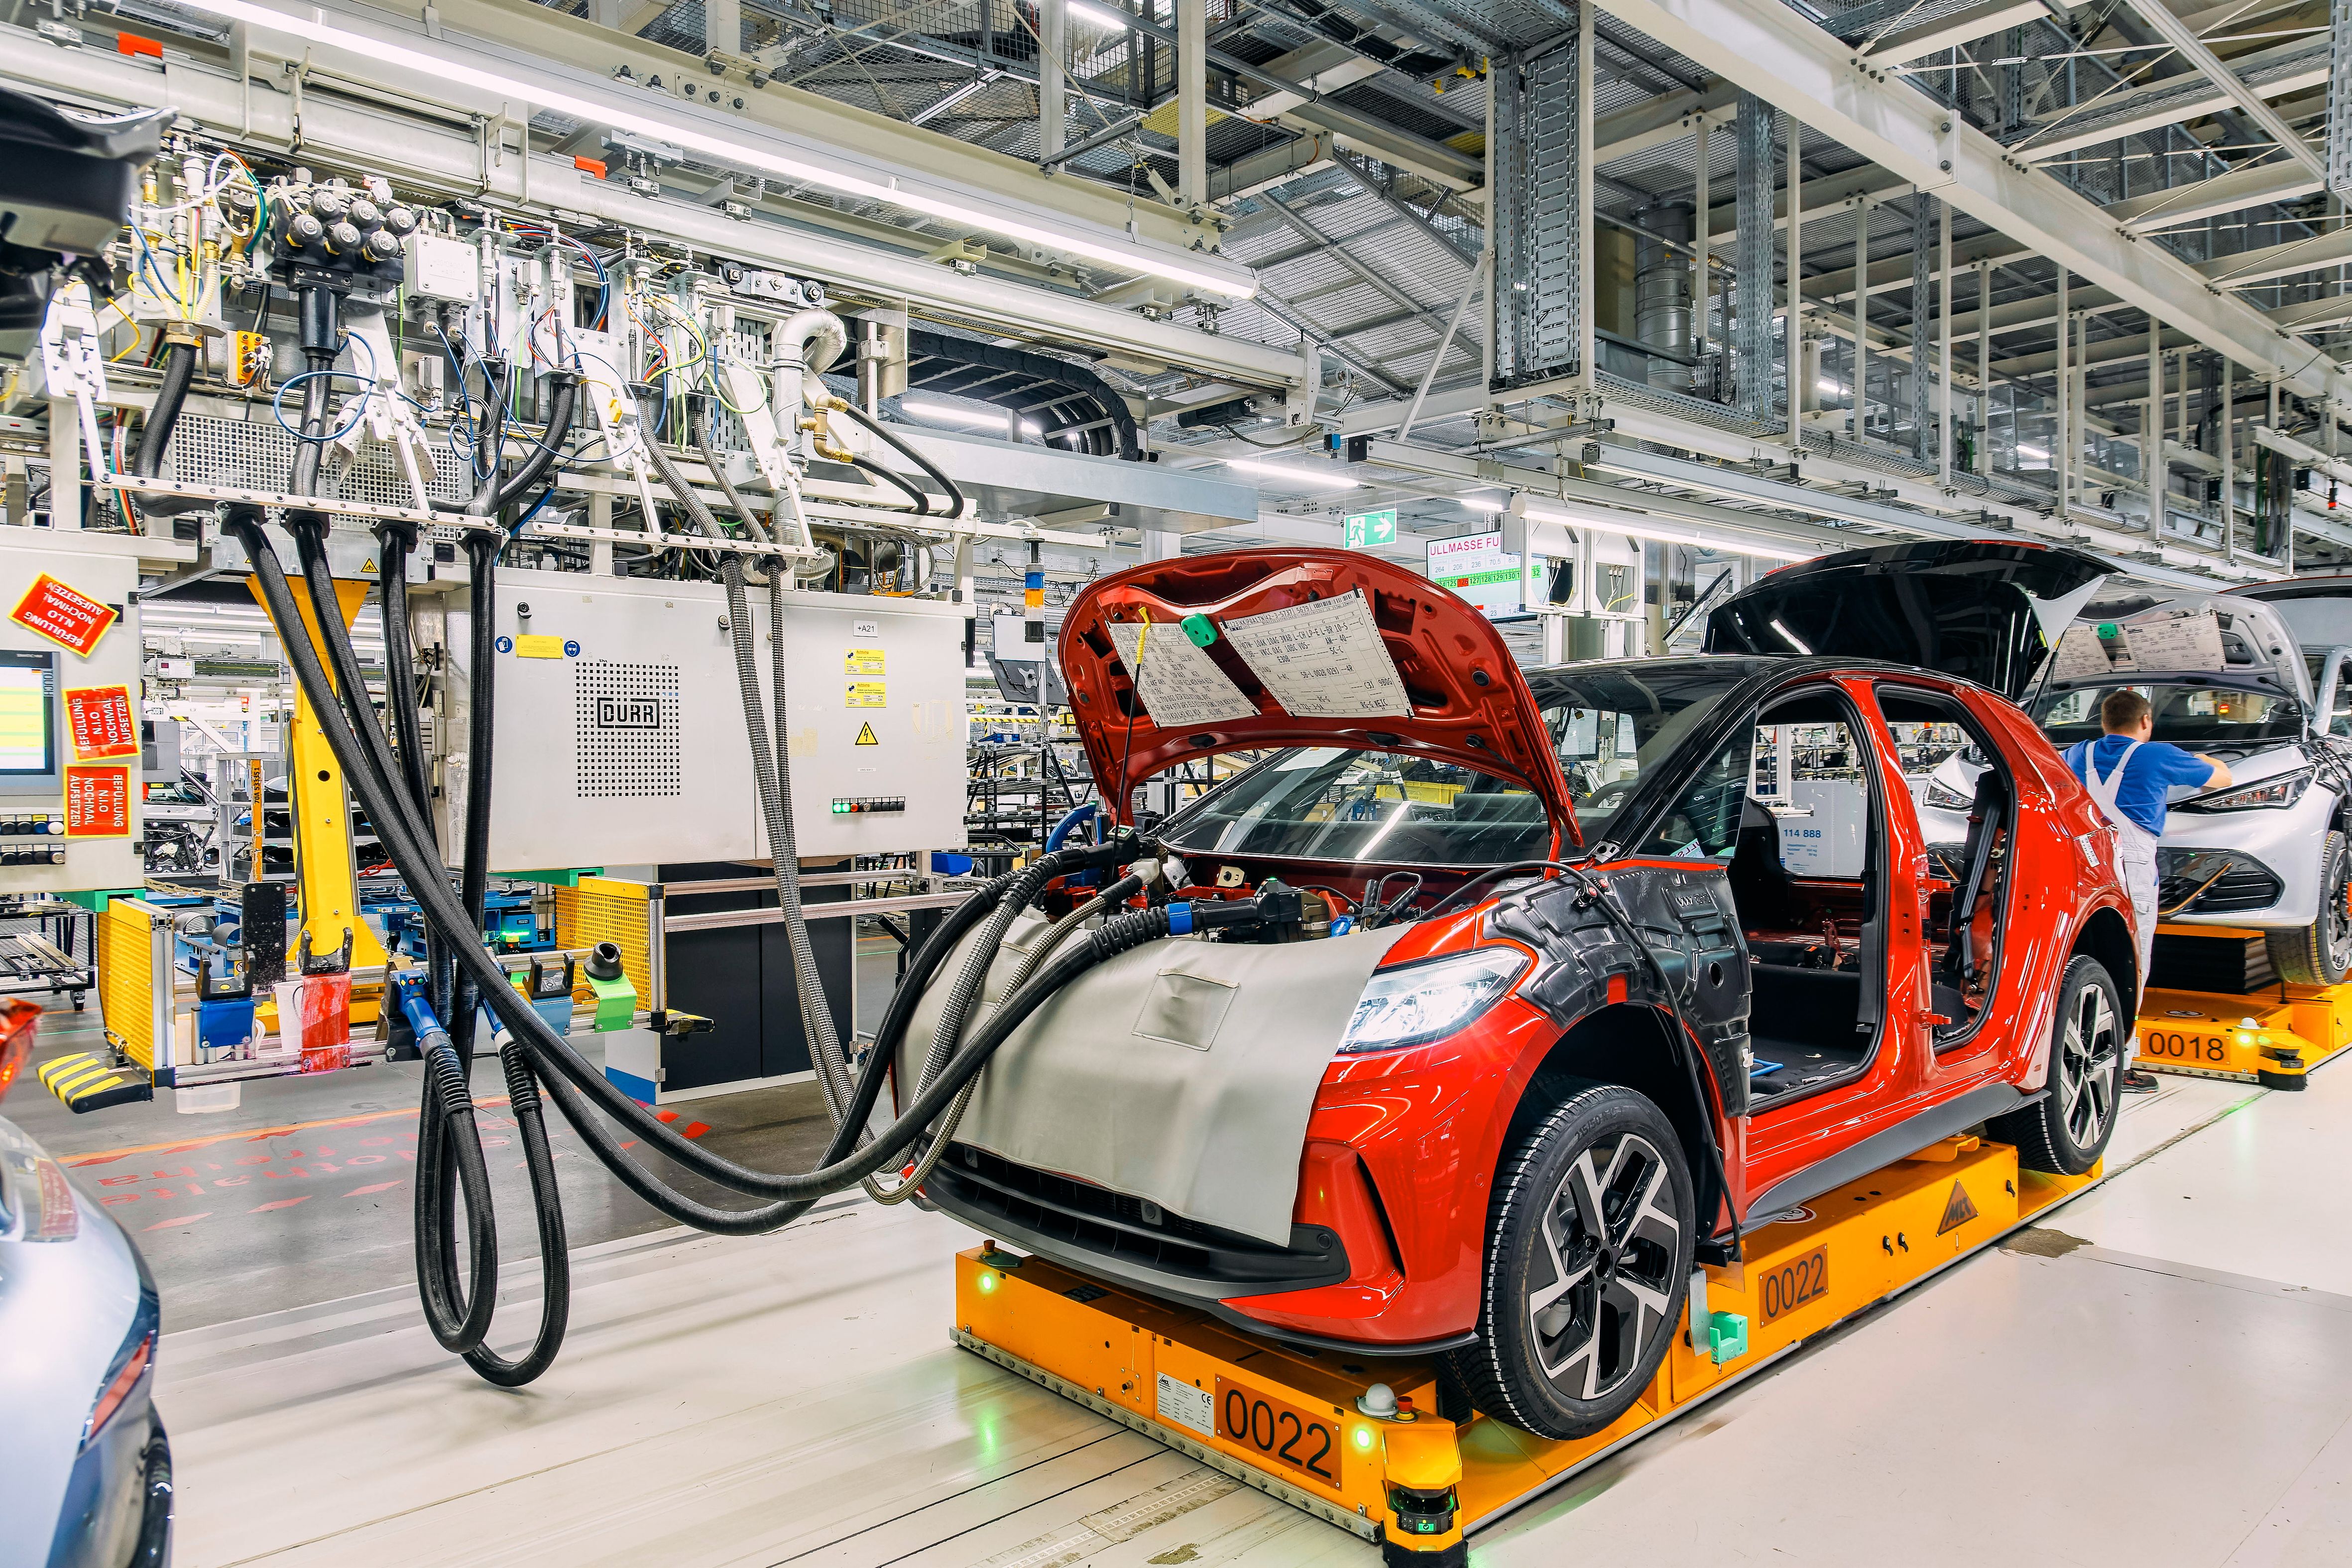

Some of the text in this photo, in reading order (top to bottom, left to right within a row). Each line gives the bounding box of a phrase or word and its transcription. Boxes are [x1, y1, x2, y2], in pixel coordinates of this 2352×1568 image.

[1487, 536, 1501, 548] FU
[43, 592, 96, 625] NOCHMAL
[46, 581, 105, 616] AUFSETZEN
[23, 611, 84, 647] BEFÜLLUNG
[43, 670, 54, 696] TOUCH
[73, 698, 92, 751] BEFÜLLUNG
[105, 698, 118, 744] NOCHMAL
[116, 695, 133, 745] AUFSETZEN
[70, 775, 81, 827] AUFSETZEN
[84, 778, 94, 825] NOCHMAL
[113, 775, 123, 827] BEFÜLLUNG
[2148, 1032, 2225, 1061] 0018
[1765, 1252, 1825, 1319] 0022
[1224, 1388, 1333, 1480] 0022
